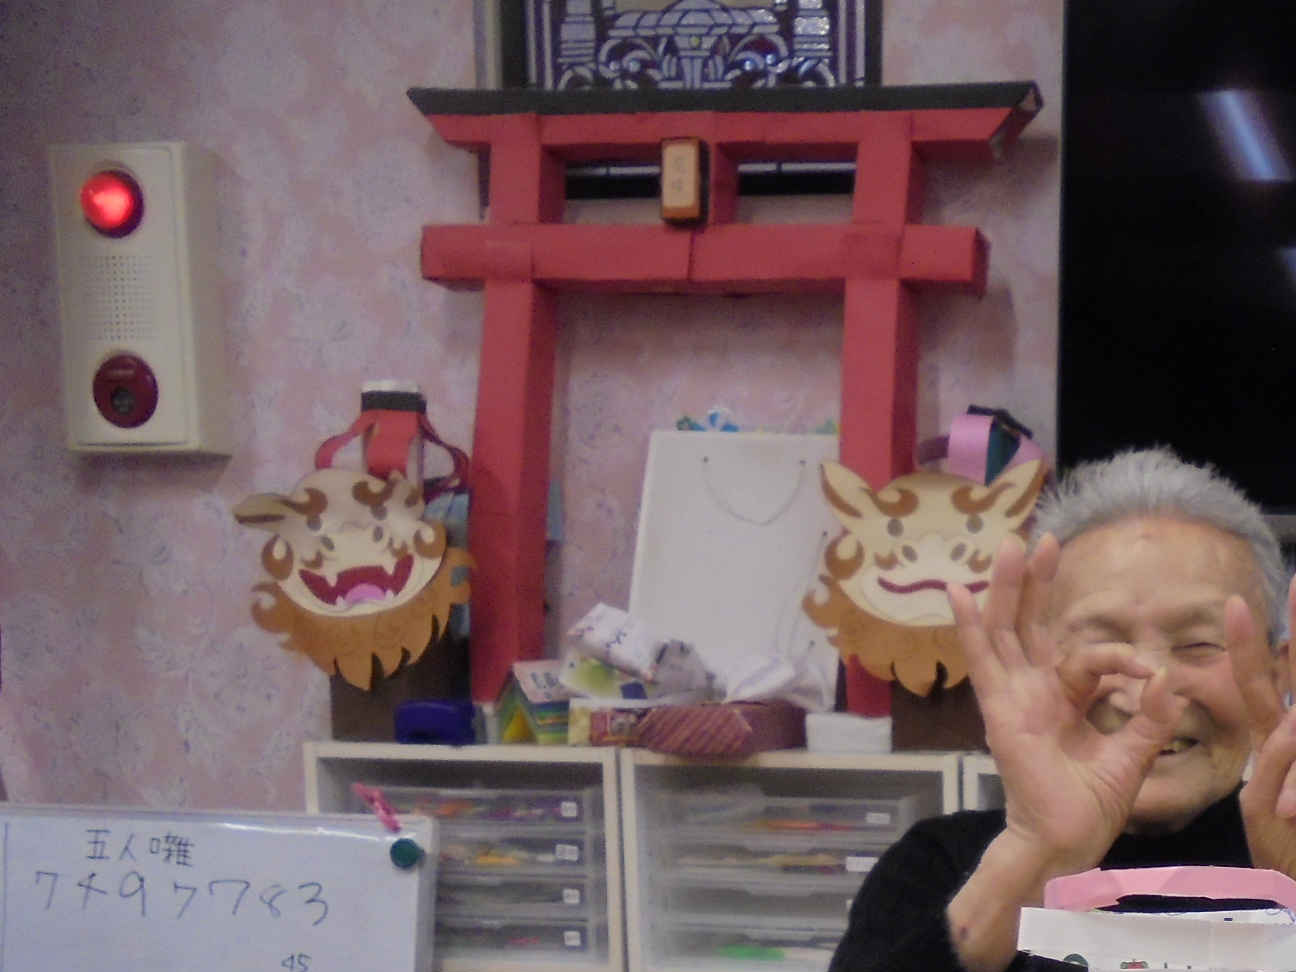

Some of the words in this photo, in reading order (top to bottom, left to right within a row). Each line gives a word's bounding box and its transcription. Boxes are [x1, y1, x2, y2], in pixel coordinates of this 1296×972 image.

[35, 872, 59, 910] 7
[119, 872, 147, 917] 9
[172, 883, 198, 919] 7
[208, 877, 251, 916] 7
[258, 884, 289, 917] 8
[300, 882, 329, 926] 3
